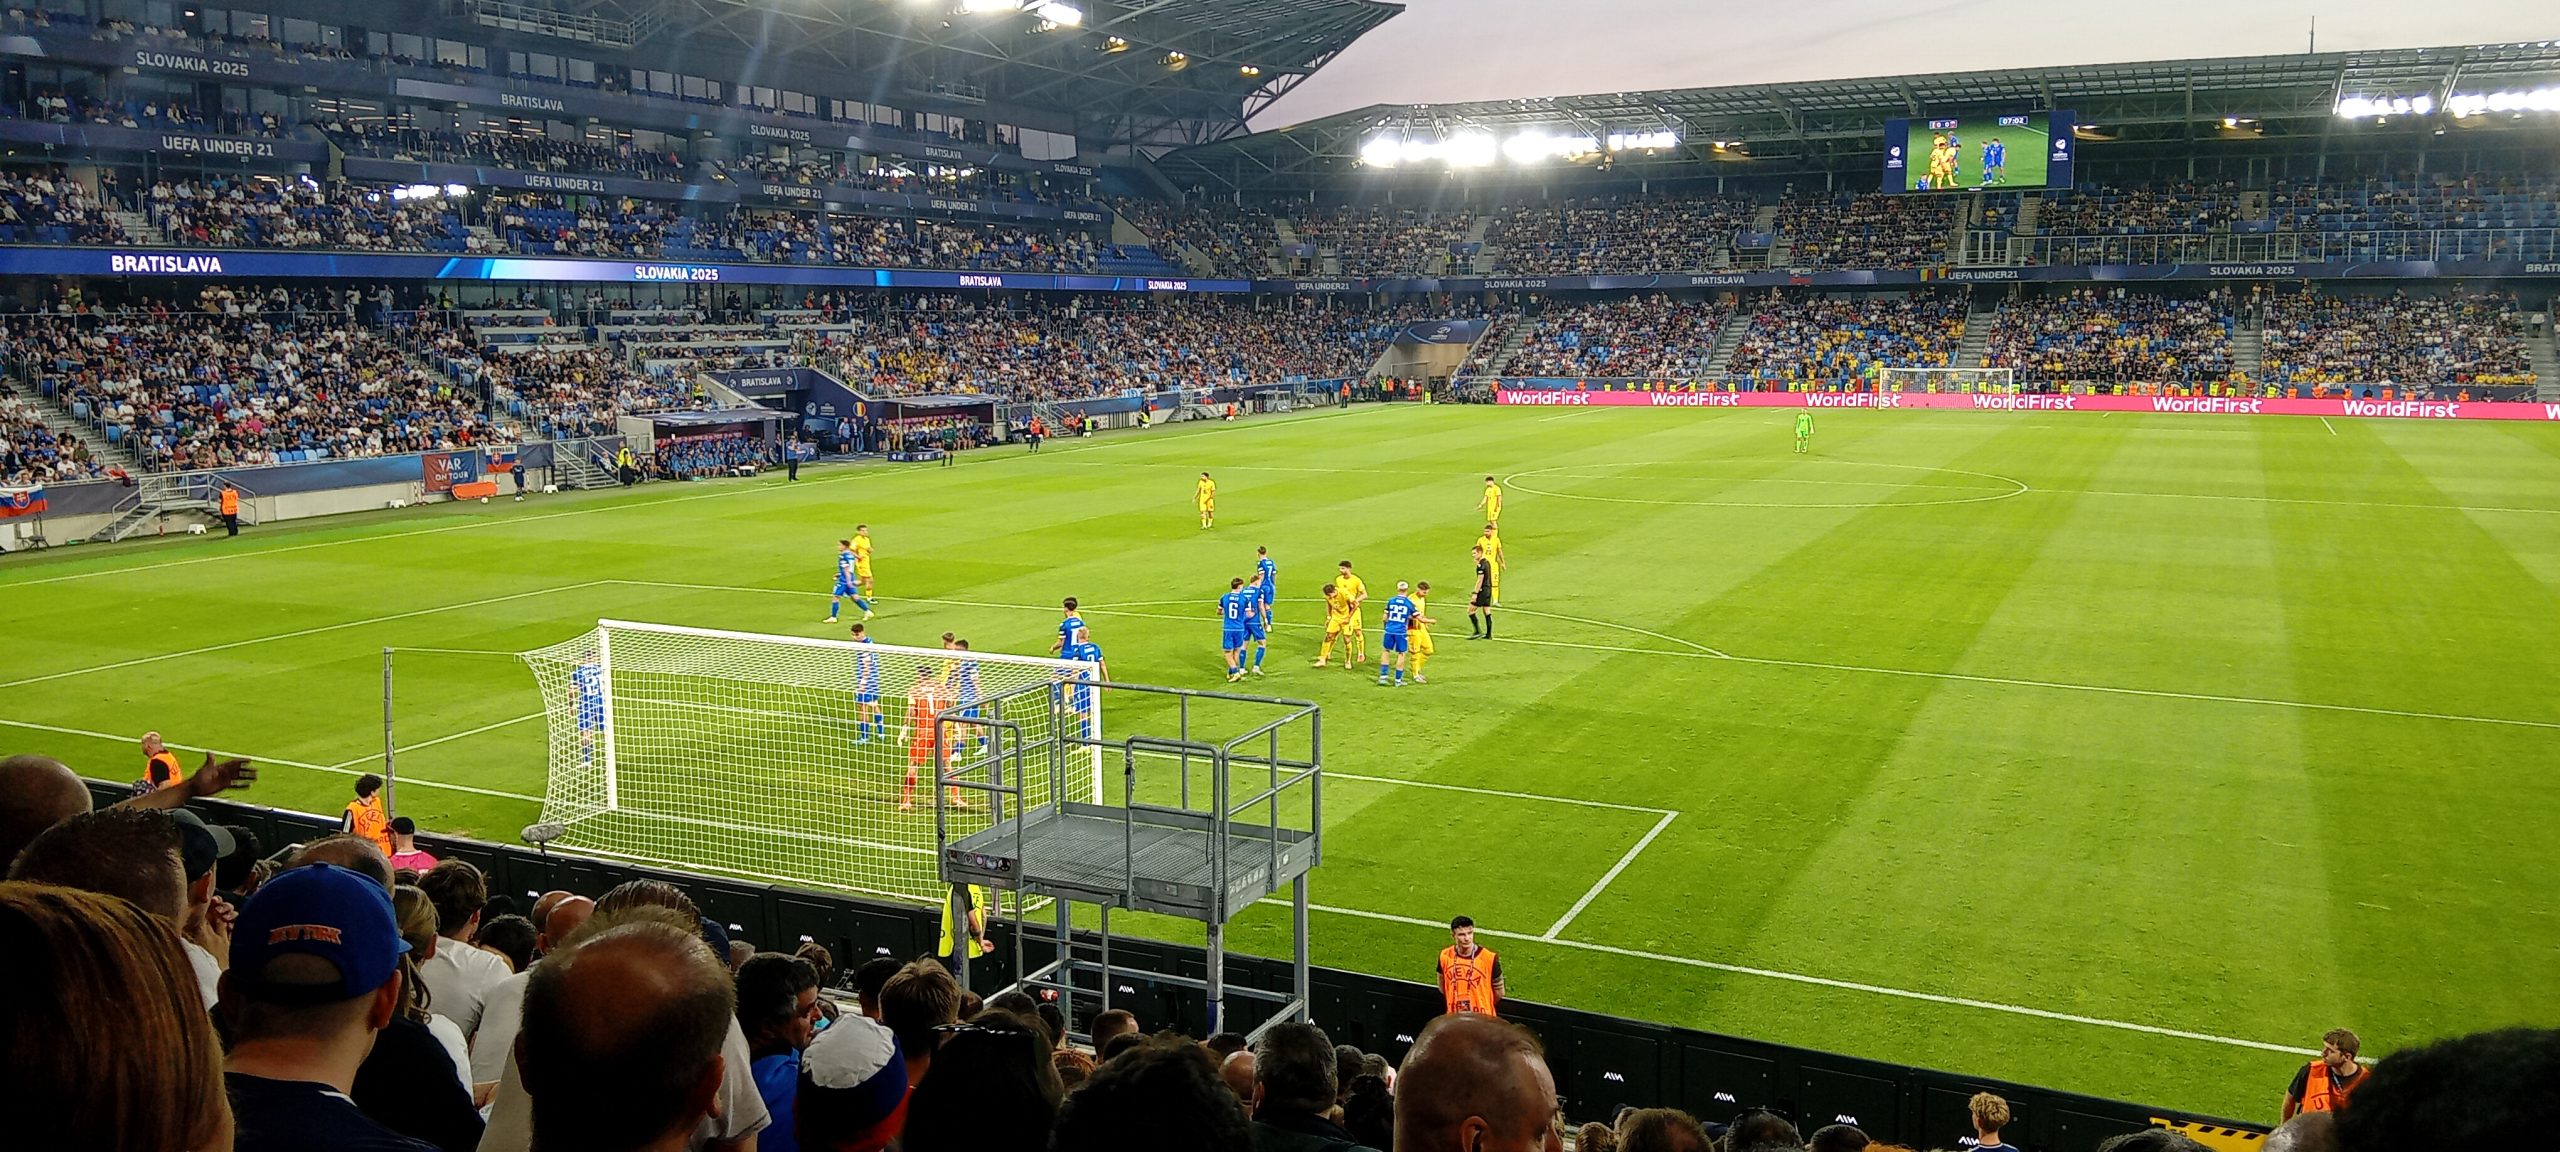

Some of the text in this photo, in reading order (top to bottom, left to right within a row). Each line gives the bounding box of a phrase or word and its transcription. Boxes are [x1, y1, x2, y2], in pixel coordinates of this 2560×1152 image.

[136, 51, 248, 76] SLOVAKIA 2025
[501, 94, 564, 112] BRATISLAVA
[2003, 117, 2024, 125] 07:02
[750, 124, 810, 140] SLOVAKIA 2025
[162, 136, 274, 156] UEFA UNDER 21
[925, 147, 962, 160] BRATISLAVA
[1054, 164, 1092, 176] SLOVAKIA 2025
[525, 175, 604, 192] UEFA UNDER 21
[763, 184, 822, 199] UEFA UNDER 21
[931, 199, 978, 212] UEFA UNDER 21
[1063, 210, 1101, 222] UEFA UNDER 21
[111, 255, 222, 272] BRATISLAVA
[635, 266, 718, 280] SLOVAKIA 2025
[1948, 272, 1973, 280] UEFA
[2210, 266, 2295, 275] SLOVAKIA 2025
[960, 276, 1002, 287] BRATISLAVA
[1148, 280, 1187, 290] SLOVAKIA 2025
[1295, 282, 1314, 290] UEFA
[1484, 280, 1547, 289] SLOVAKIA 2025
[1692, 276, 1745, 285] BRATISLAVA
[741, 377, 782, 387] BRATISLAVA
[1507, 391, 1590, 405] WorldFirst
[1650, 392, 1740, 406] WorldFirst
[1805, 392, 1902, 407] WorldFirst
[1973, 394, 2076, 409] WorldFirst
[2152, 396, 2263, 413] WorldFirst
[2343, 400, 2460, 417] WorldFirst
[438, 458, 461, 471] VAR
[435, 470, 468, 481] ON TOUR
[1267, 566, 1273, 577] 7
[1229, 602, 1238, 619] 6
[1389, 604, 1408, 623] 22
